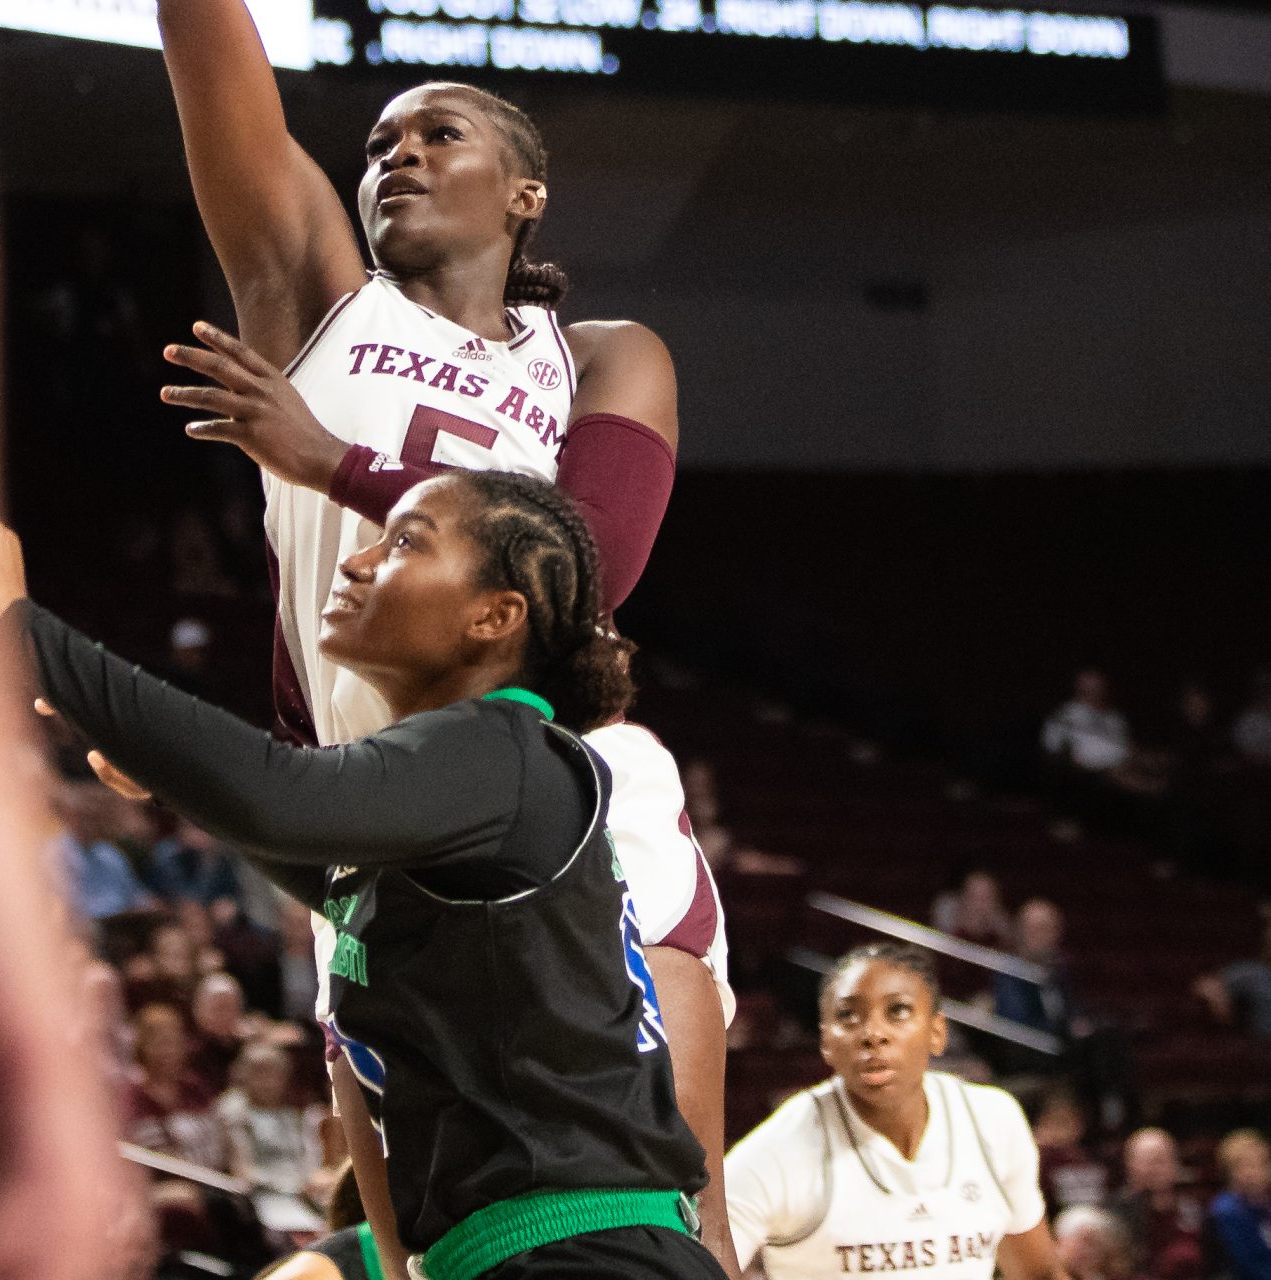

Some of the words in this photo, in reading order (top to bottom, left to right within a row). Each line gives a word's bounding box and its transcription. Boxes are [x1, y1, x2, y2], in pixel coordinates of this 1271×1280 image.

[452, 349, 493, 362] adidas
[530, 363, 558, 388] SEC
[348, 343, 490, 398] TEXAS
[495, 385, 568, 463] A&M
[834, 1238, 937, 1273] TEXAS
